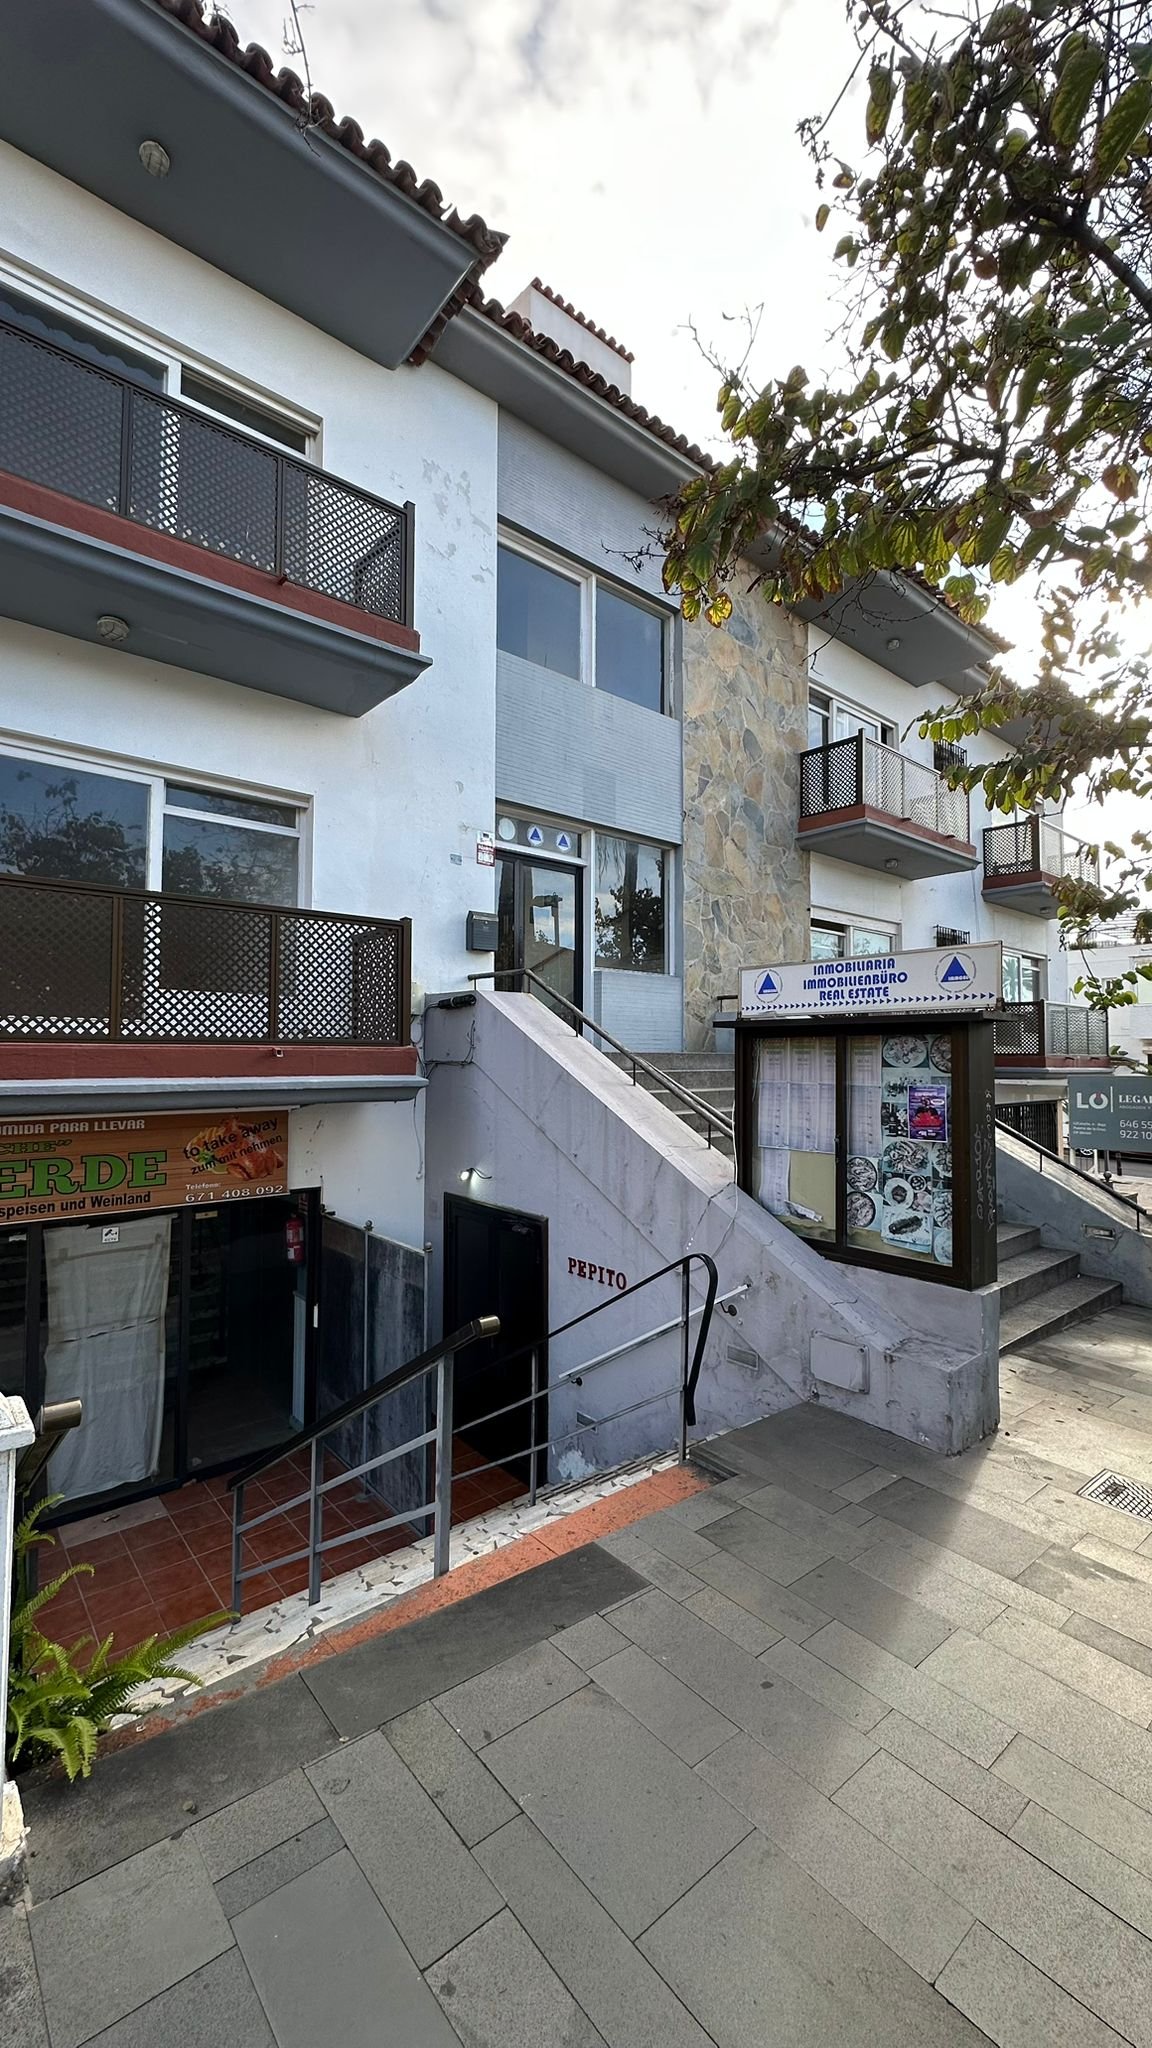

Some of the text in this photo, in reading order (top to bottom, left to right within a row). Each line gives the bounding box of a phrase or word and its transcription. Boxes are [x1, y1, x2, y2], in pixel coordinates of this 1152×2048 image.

[813, 958, 896, 976] INMOBILIARIA
[803, 970, 908, 990] IMMOBILIENBÜRO
[819, 986, 889, 1001] REAL ESTATE
[0, 1119, 145, 1136] MIDA PARA LLEVAR
[1119, 1119, 1140, 1129] 646
[183, 1118, 278, 1160] to take away
[1119, 1129, 1140, 1139] 922
[191, 1135, 283, 1175] zum mit nehmen
[0, 1150, 168, 1200] ERDE
[60, 1196, 86, 1212] und
[90, 1190, 152, 1209] Weinland
[185, 1184, 284, 1203] 671 408 092
[567, 1256, 628, 1291] PEPITO
